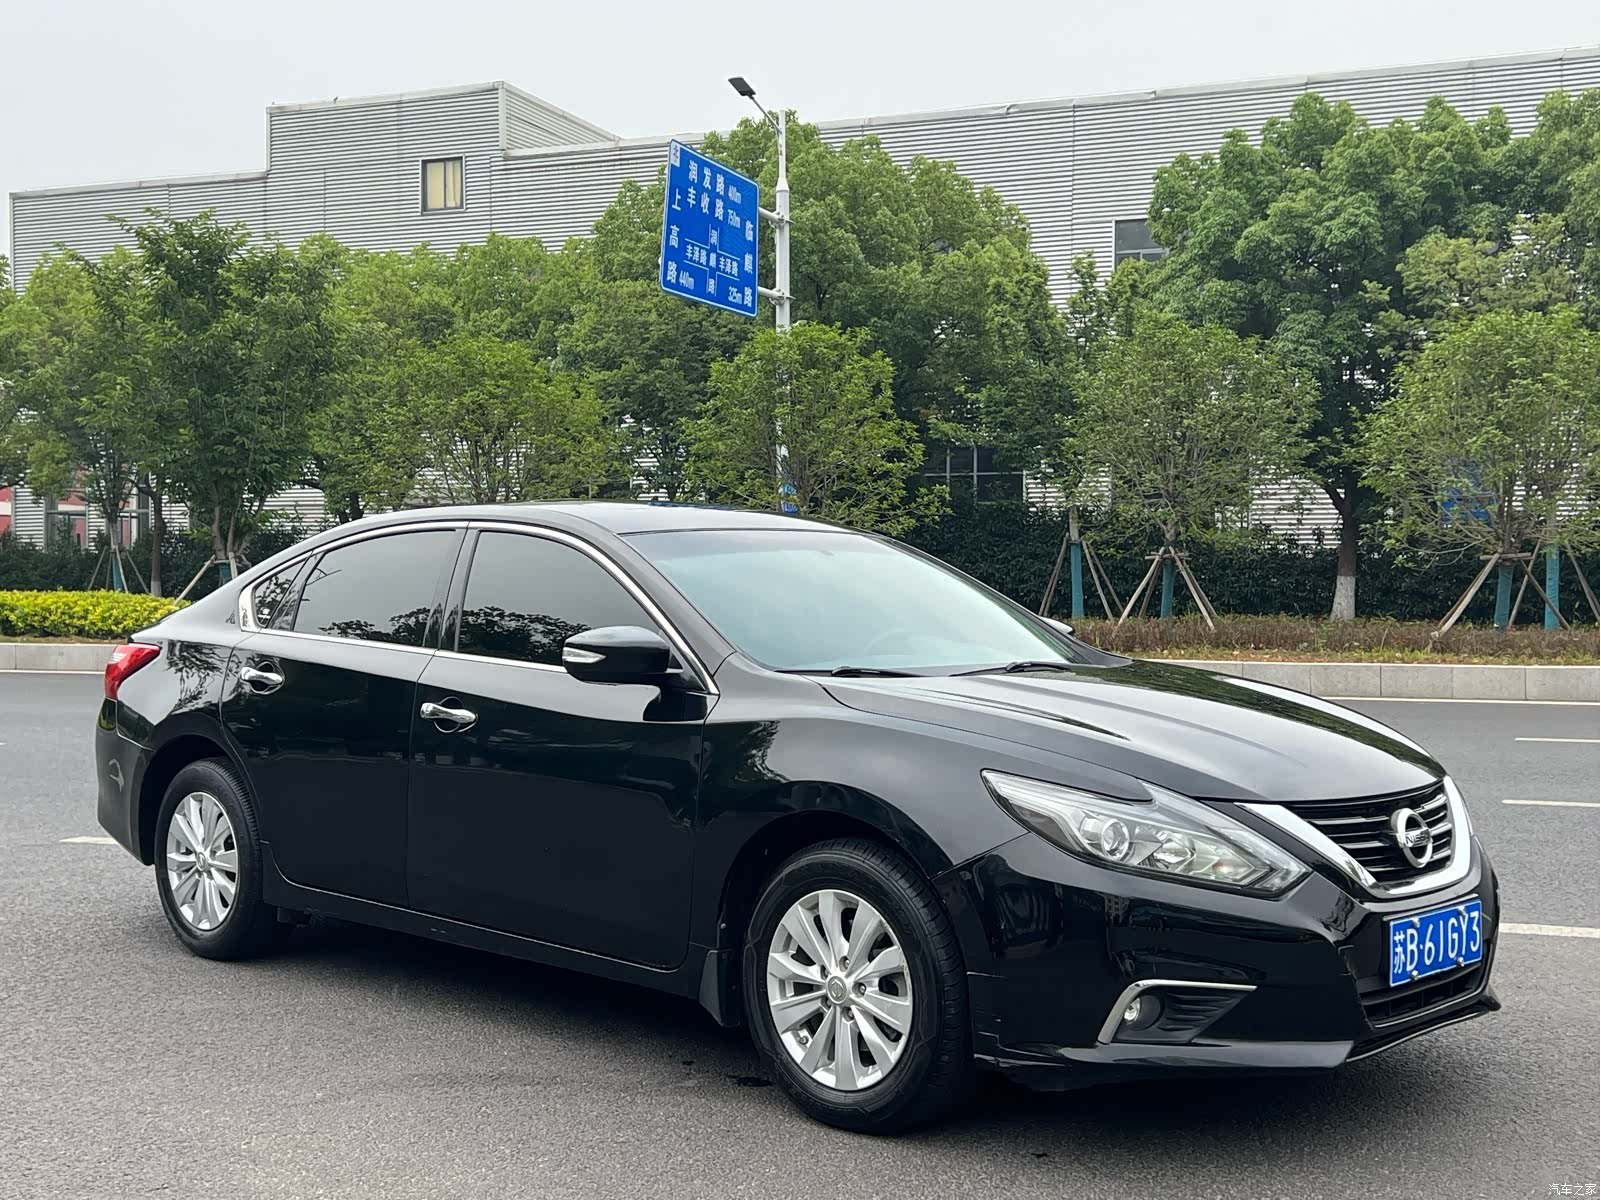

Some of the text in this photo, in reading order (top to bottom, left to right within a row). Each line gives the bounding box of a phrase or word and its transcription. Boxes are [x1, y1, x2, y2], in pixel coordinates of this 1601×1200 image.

[688, 159, 725, 196] 润发路
[686, 186, 724, 221] 丰收路
[666, 187, 682, 284] 上高路
[685, 243, 707, 266] 丰泽路
[718, 256, 739, 277] 丰泽路
[1405, 829, 1430, 845] NISS
